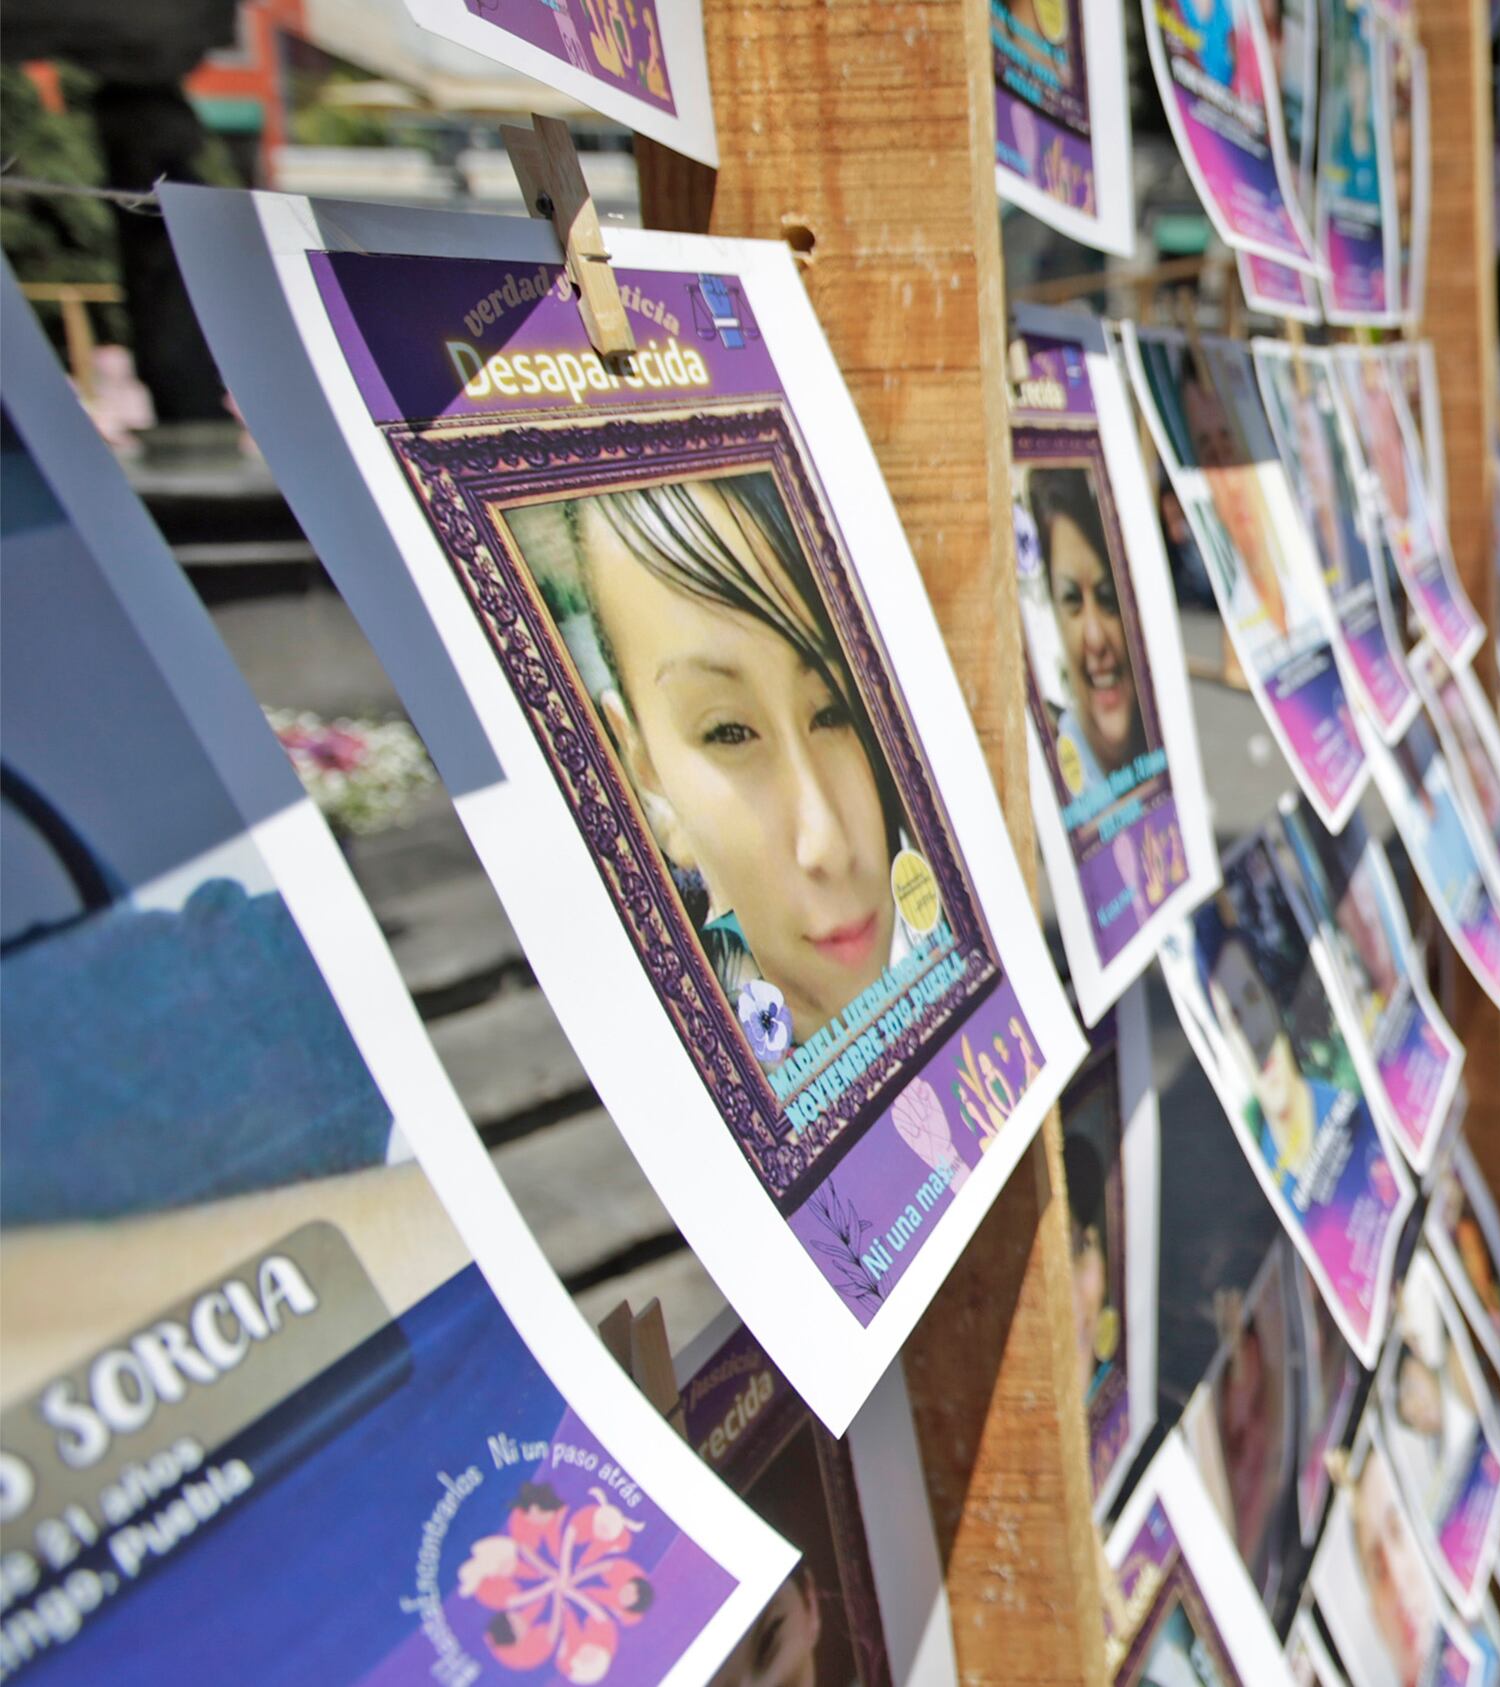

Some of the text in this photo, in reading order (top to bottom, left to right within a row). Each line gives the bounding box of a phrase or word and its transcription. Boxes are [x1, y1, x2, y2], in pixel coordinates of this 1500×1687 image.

[463, 265, 553, 338] verdad
[555, 271, 573, 302] y
[445, 336, 710, 405] Desaparecida
[767, 1016, 850, 1103] MARIELA
[783, 1025, 886, 1135] NOVIEMBRE
[862, 1237, 894, 1281] Ni
[885, 1203, 923, 1252] una
[39, 1254, 319, 1470] SORCIA
[101, 1436, 205, 1527] años
[487, 1432, 644, 1508] Ni un paso atrás
